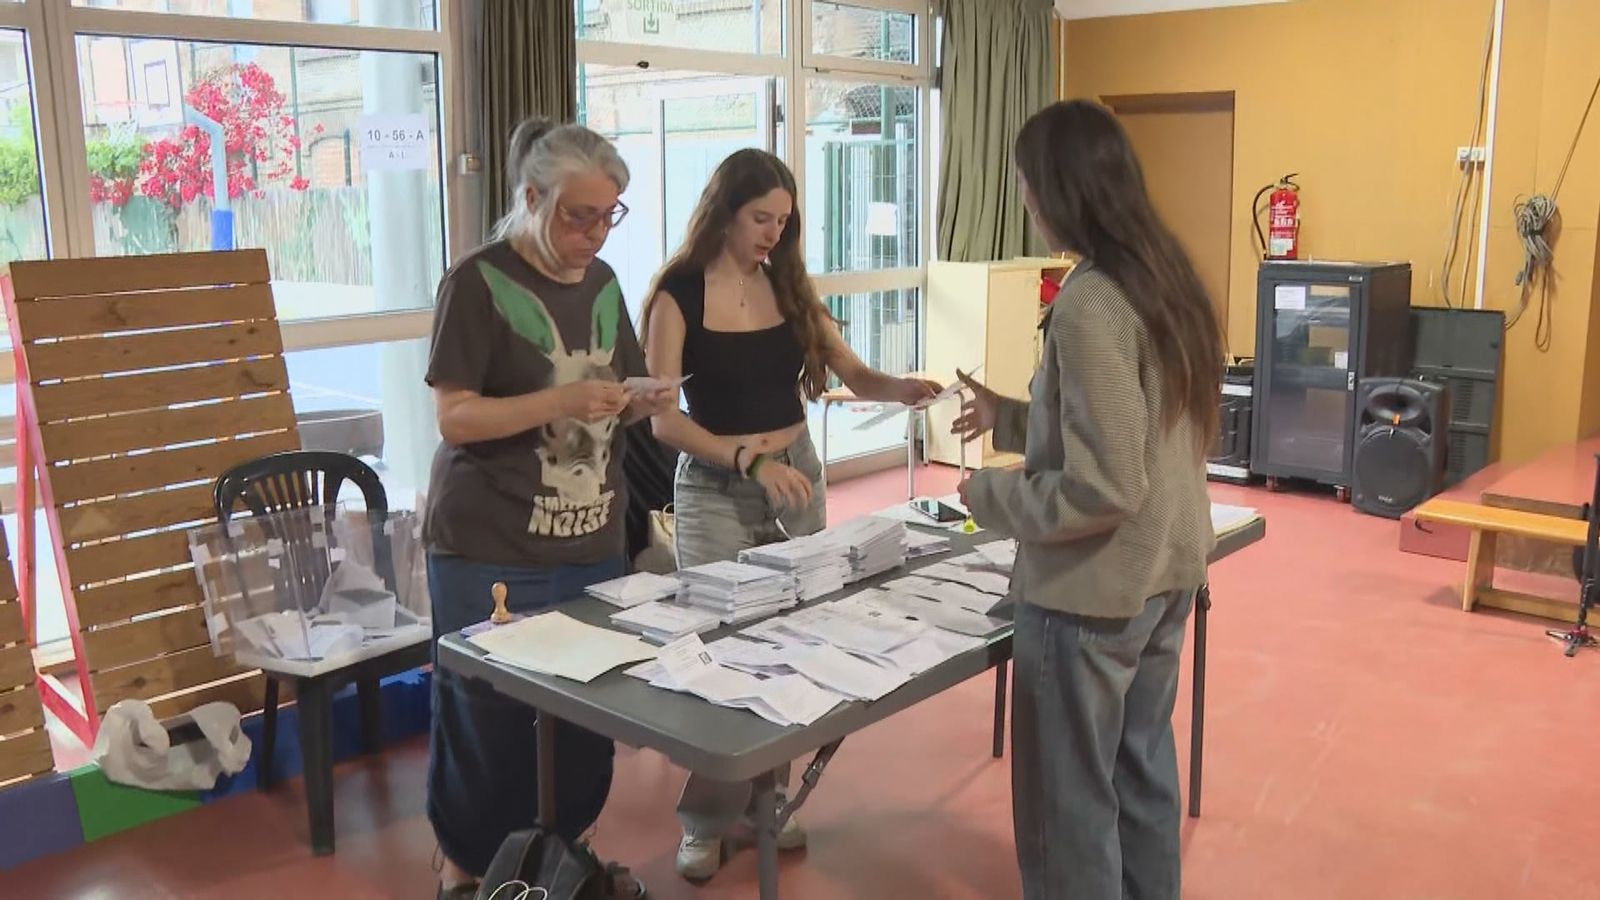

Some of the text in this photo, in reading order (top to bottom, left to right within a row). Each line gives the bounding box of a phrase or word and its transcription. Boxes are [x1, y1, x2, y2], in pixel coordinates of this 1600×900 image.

[627, 0, 675, 13] SORTIDA
[368, 129, 381, 141] 10
[392, 129, 406, 141] 56
[416, 129, 424, 141] A
[527, 503, 610, 536] NOISE
